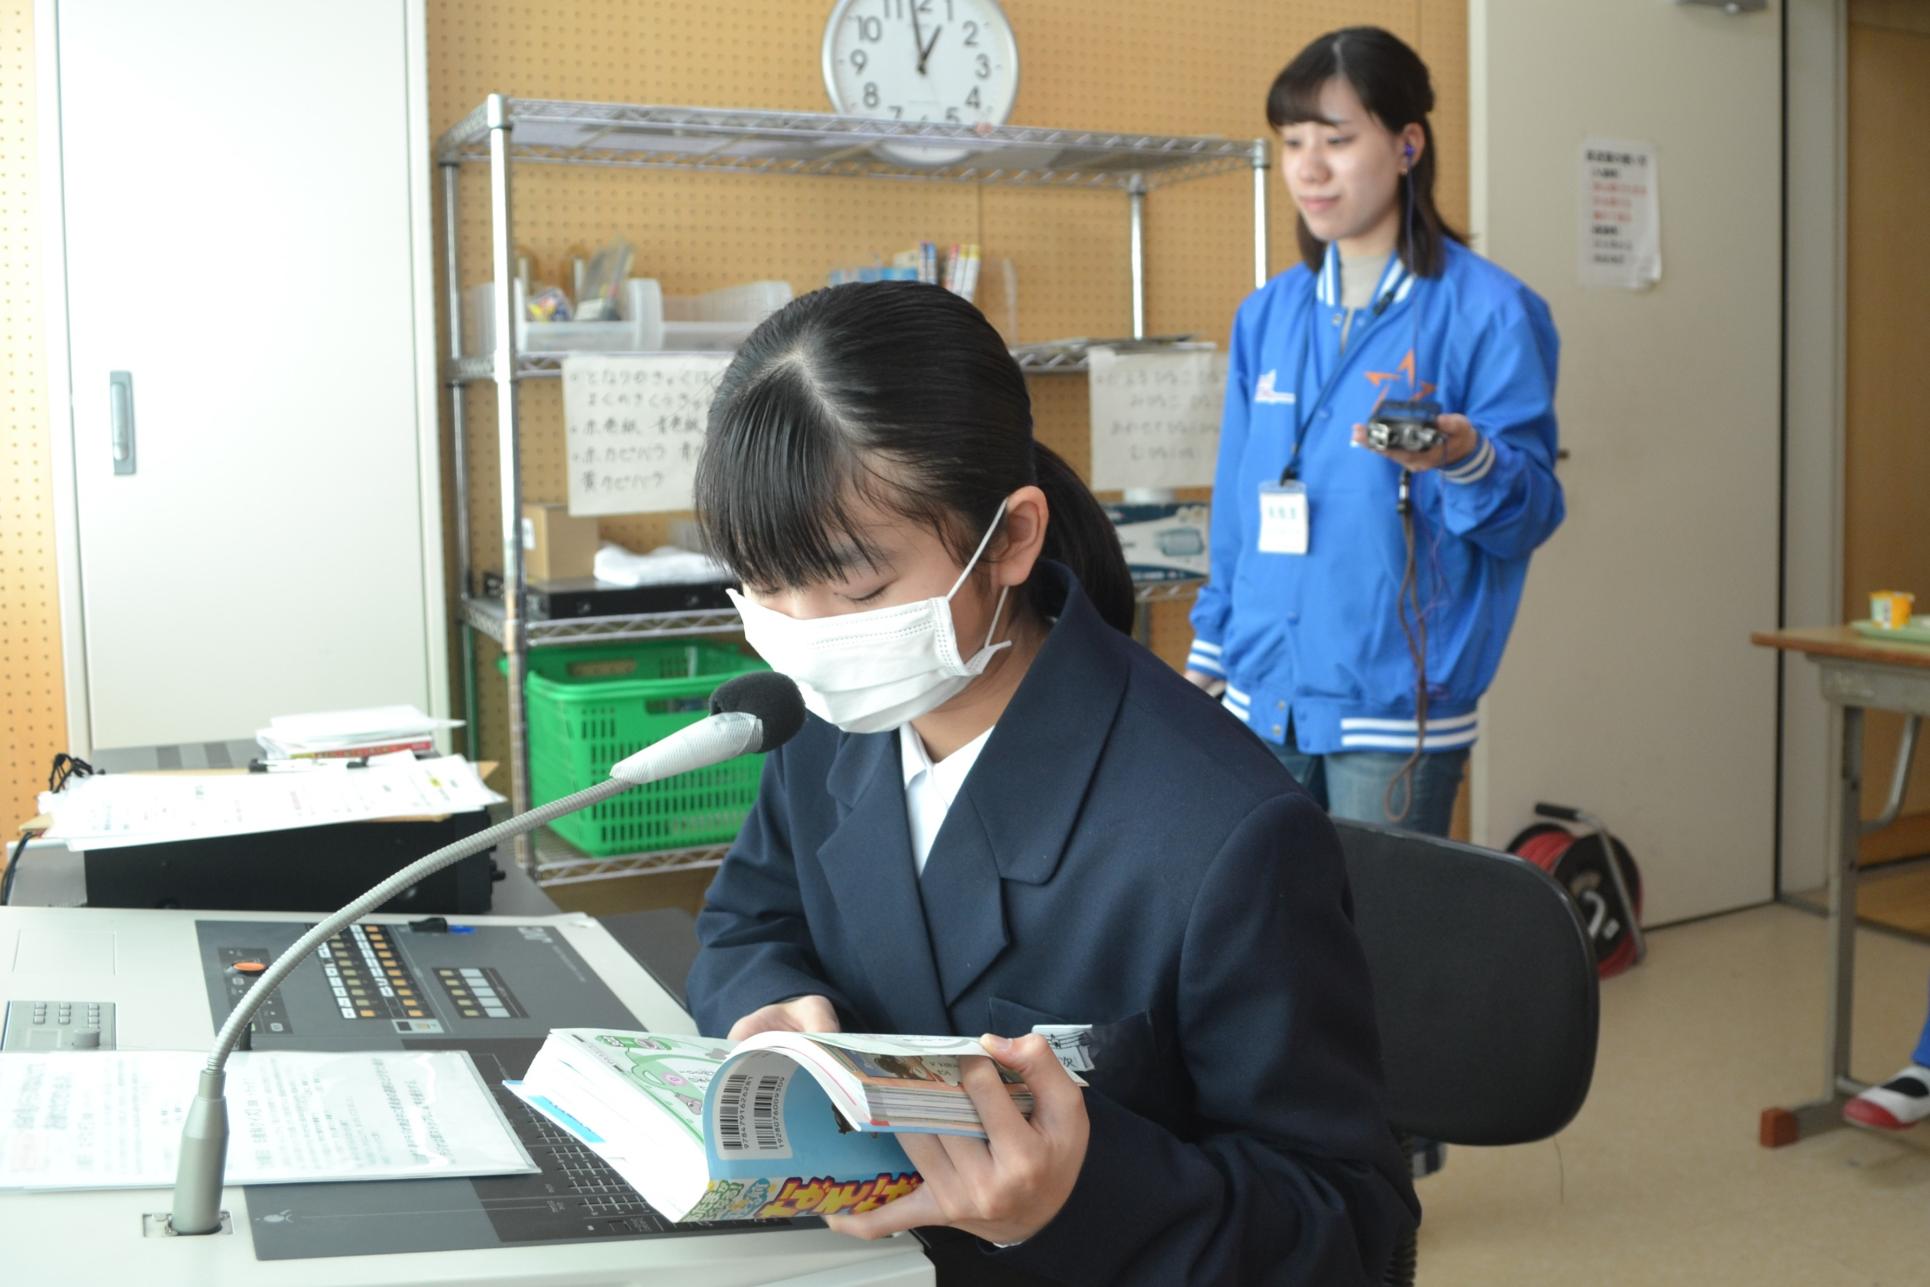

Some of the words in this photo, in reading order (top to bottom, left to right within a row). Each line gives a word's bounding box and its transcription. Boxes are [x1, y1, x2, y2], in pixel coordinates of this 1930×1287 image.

[857, 16, 882, 42] 10
[962, 20, 978, 47] 2
[851, 49, 867, 76] 9
[975, 53, 991, 80] 3
[863, 81, 880, 109] 8
[965, 86, 981, 110] 4
